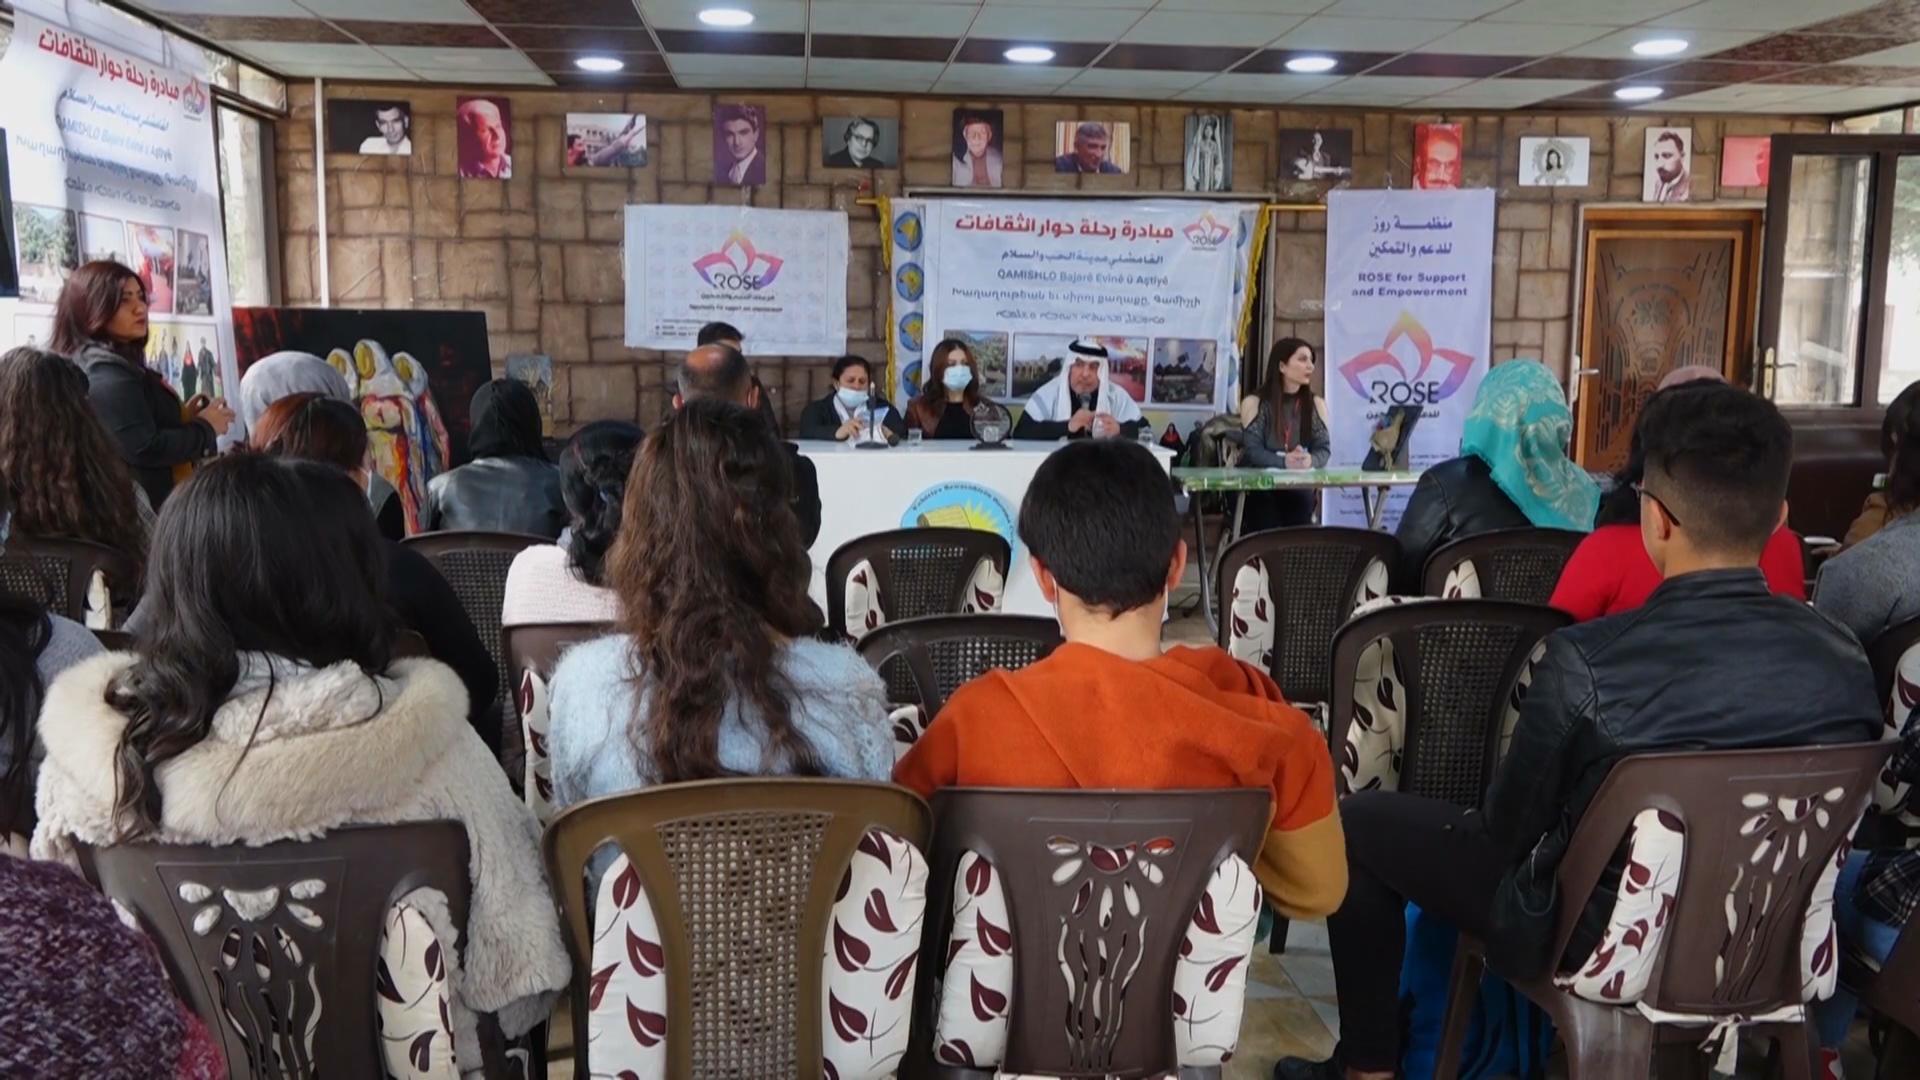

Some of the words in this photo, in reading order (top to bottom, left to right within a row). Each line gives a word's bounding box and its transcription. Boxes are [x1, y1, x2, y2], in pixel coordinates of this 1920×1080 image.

[38, 29, 97, 67] الثقافات
[98, 52, 123, 80] حوار
[125, 60, 149, 94] رحلة
[152, 70, 180, 104] مبادرة
[955, 212, 1036, 233] الثقافات
[1038, 217, 1075, 238] حوار
[1080, 217, 1117, 240] رحلة
[1122, 220, 1174, 243] مبادرة
[1372, 216, 1391, 233] روز
[1001, 248, 1045, 262] والسلام
[1045, 249, 1076, 262] الحب
[1076, 249, 1108, 264] مدينة
[1368, 240, 1417, 259] والتمكين
[1418, 241, 1453, 257] للدعم
[1109, 251, 1164, 267] القامشلي
[714, 272, 761, 291] ROSE
[997, 268, 1057, 281] QAMISHLO
[1358, 271, 1393, 282] ROSE
[1396, 271, 1413, 282] for
[1417, 271, 1467, 284] Support
[1352, 286, 1374, 297] and
[1378, 287, 1468, 299] Empowerment
[1369, 381, 1440, 404] ROSE
